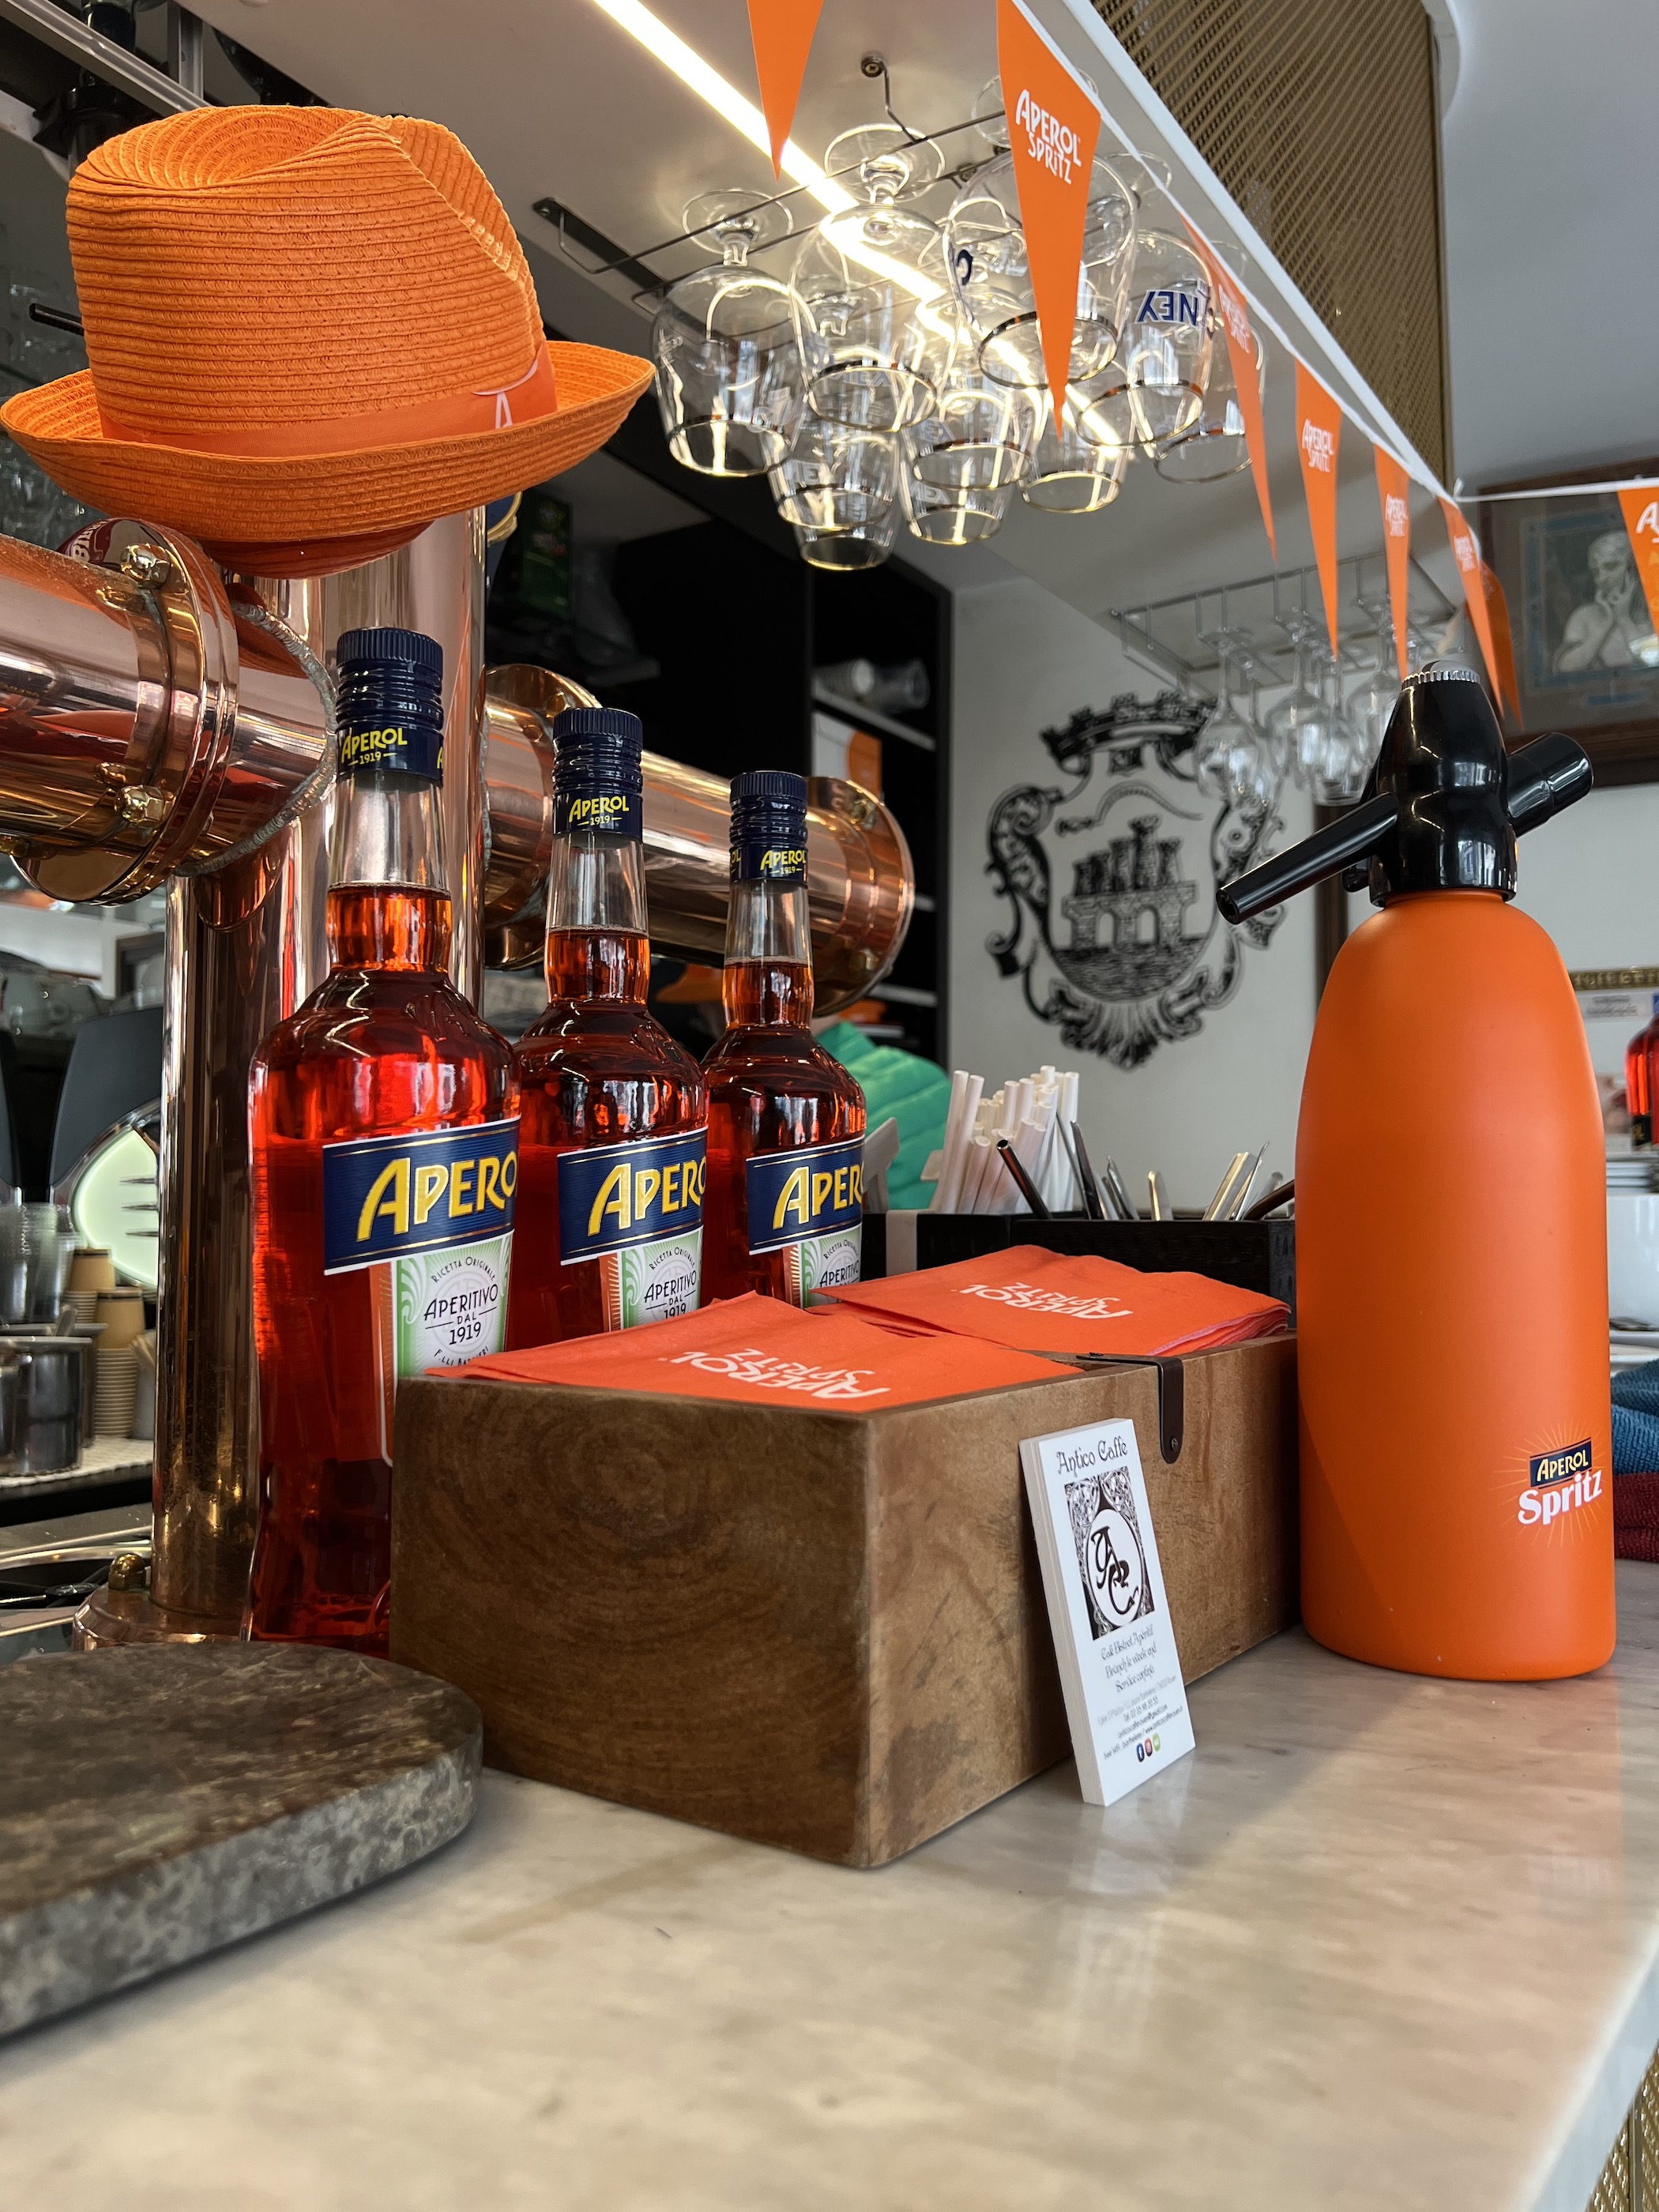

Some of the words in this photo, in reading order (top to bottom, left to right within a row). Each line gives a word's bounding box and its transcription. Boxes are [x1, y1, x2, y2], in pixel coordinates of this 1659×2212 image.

[1015, 88, 1082, 167] APEROL
[1302, 419, 1334, 455] APEROL
[341, 727, 408, 764] APEROL
[359, 751, 382, 765] 1919
[569, 796, 630, 823] APEROL
[589, 815, 611, 826] 1919
[760, 850, 806, 871] APEROL
[780, 866, 796, 875] 1919
[773, 1160, 865, 1230] APER
[431, 1260, 463, 1283] RICETTA
[465, 1256, 496, 1281] ORIGINALE
[649, 1250, 672, 1270] RICETTA
[644, 1270, 697, 1304] APERITIVO
[669, 1295, 683, 1306] DAL
[958, 1284, 1134, 1319] APEROL
[423, 1283, 498, 1321] APERITIVO
[664, 1303, 687, 1319] 1919
[457, 1311, 477, 1325] DAL
[449, 1321, 481, 1345] 1919
[670, 1351, 891, 1399] APEROL
[1056, 1446, 1096, 1478] Antico
[1537, 1449, 1589, 1482] APEROL
[1517, 1469, 1603, 1525] Spritz
